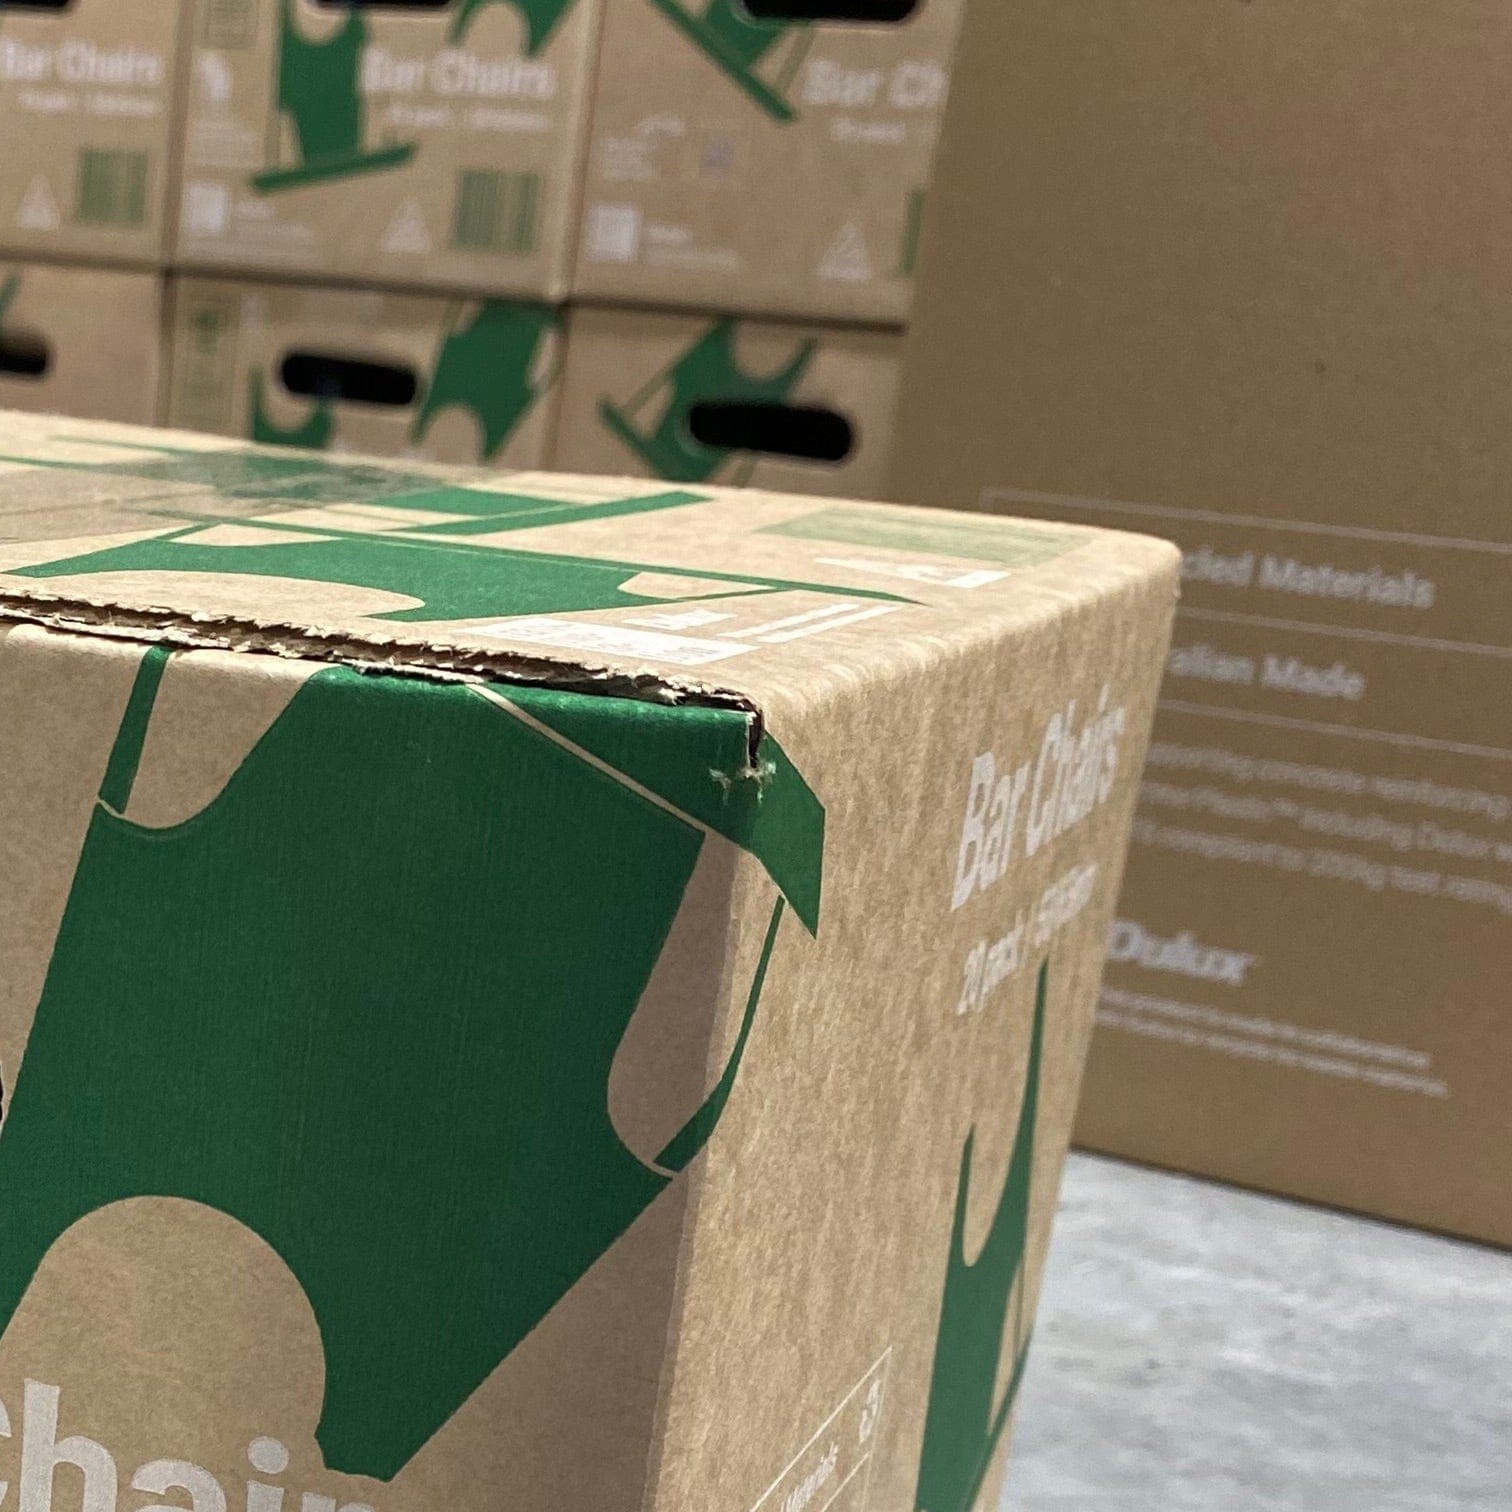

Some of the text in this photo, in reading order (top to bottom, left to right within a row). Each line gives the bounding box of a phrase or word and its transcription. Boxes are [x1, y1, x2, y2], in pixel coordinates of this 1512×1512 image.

[950, 750, 1031, 912] Bar
[1026, 683, 1125, 858] Chairs
[1108, 920, 1252, 986] Dulux
